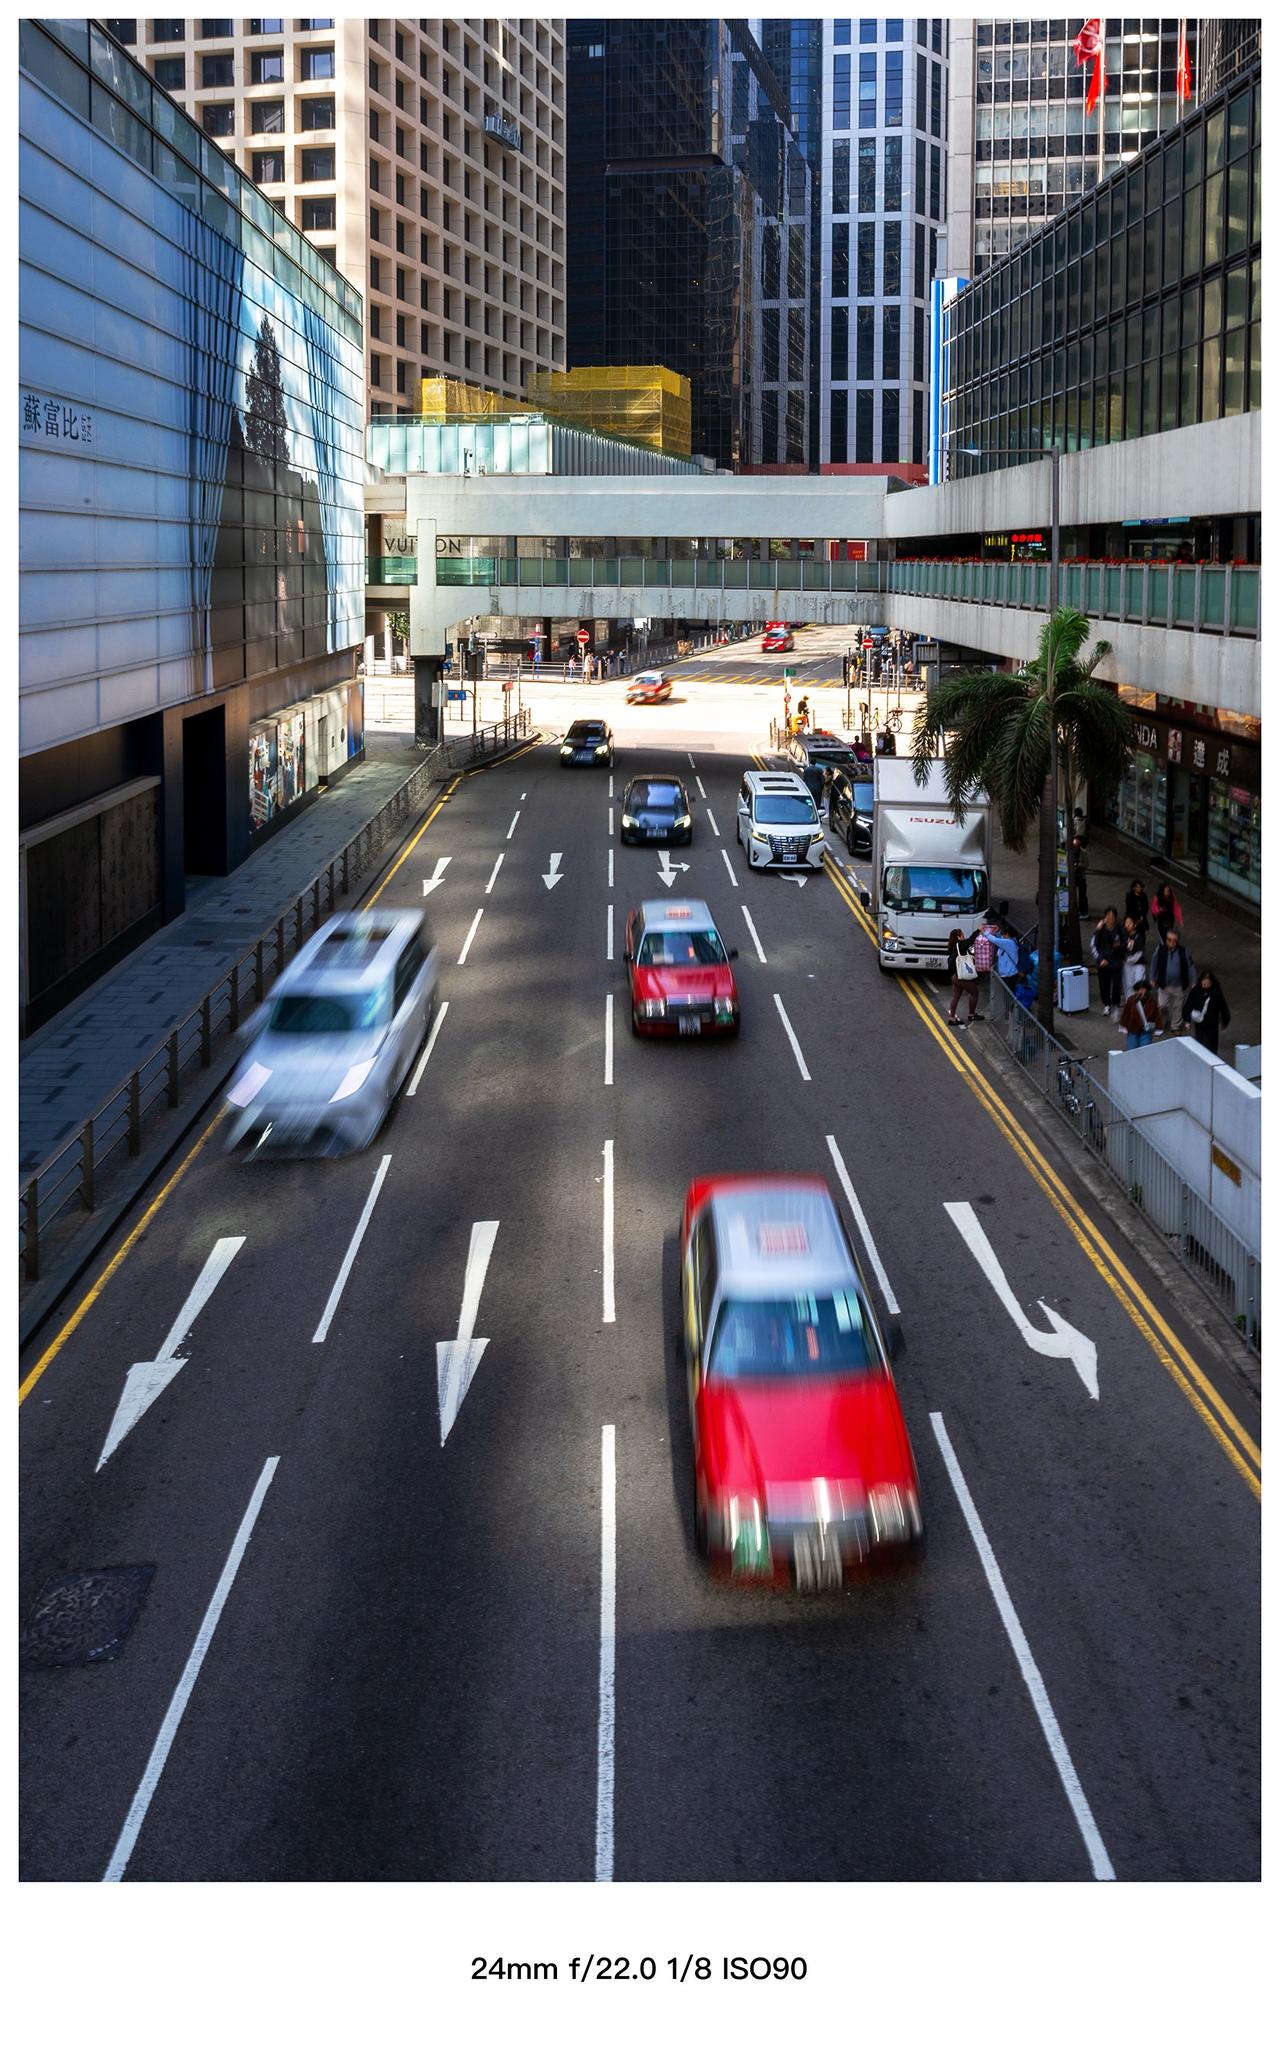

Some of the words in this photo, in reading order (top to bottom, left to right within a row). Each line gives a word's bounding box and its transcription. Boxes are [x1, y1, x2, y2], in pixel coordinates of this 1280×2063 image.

[23, 394, 80, 440] 蘇富比
[385, 538, 461, 553] VUION
[1131, 723, 1158, 749] NDA
